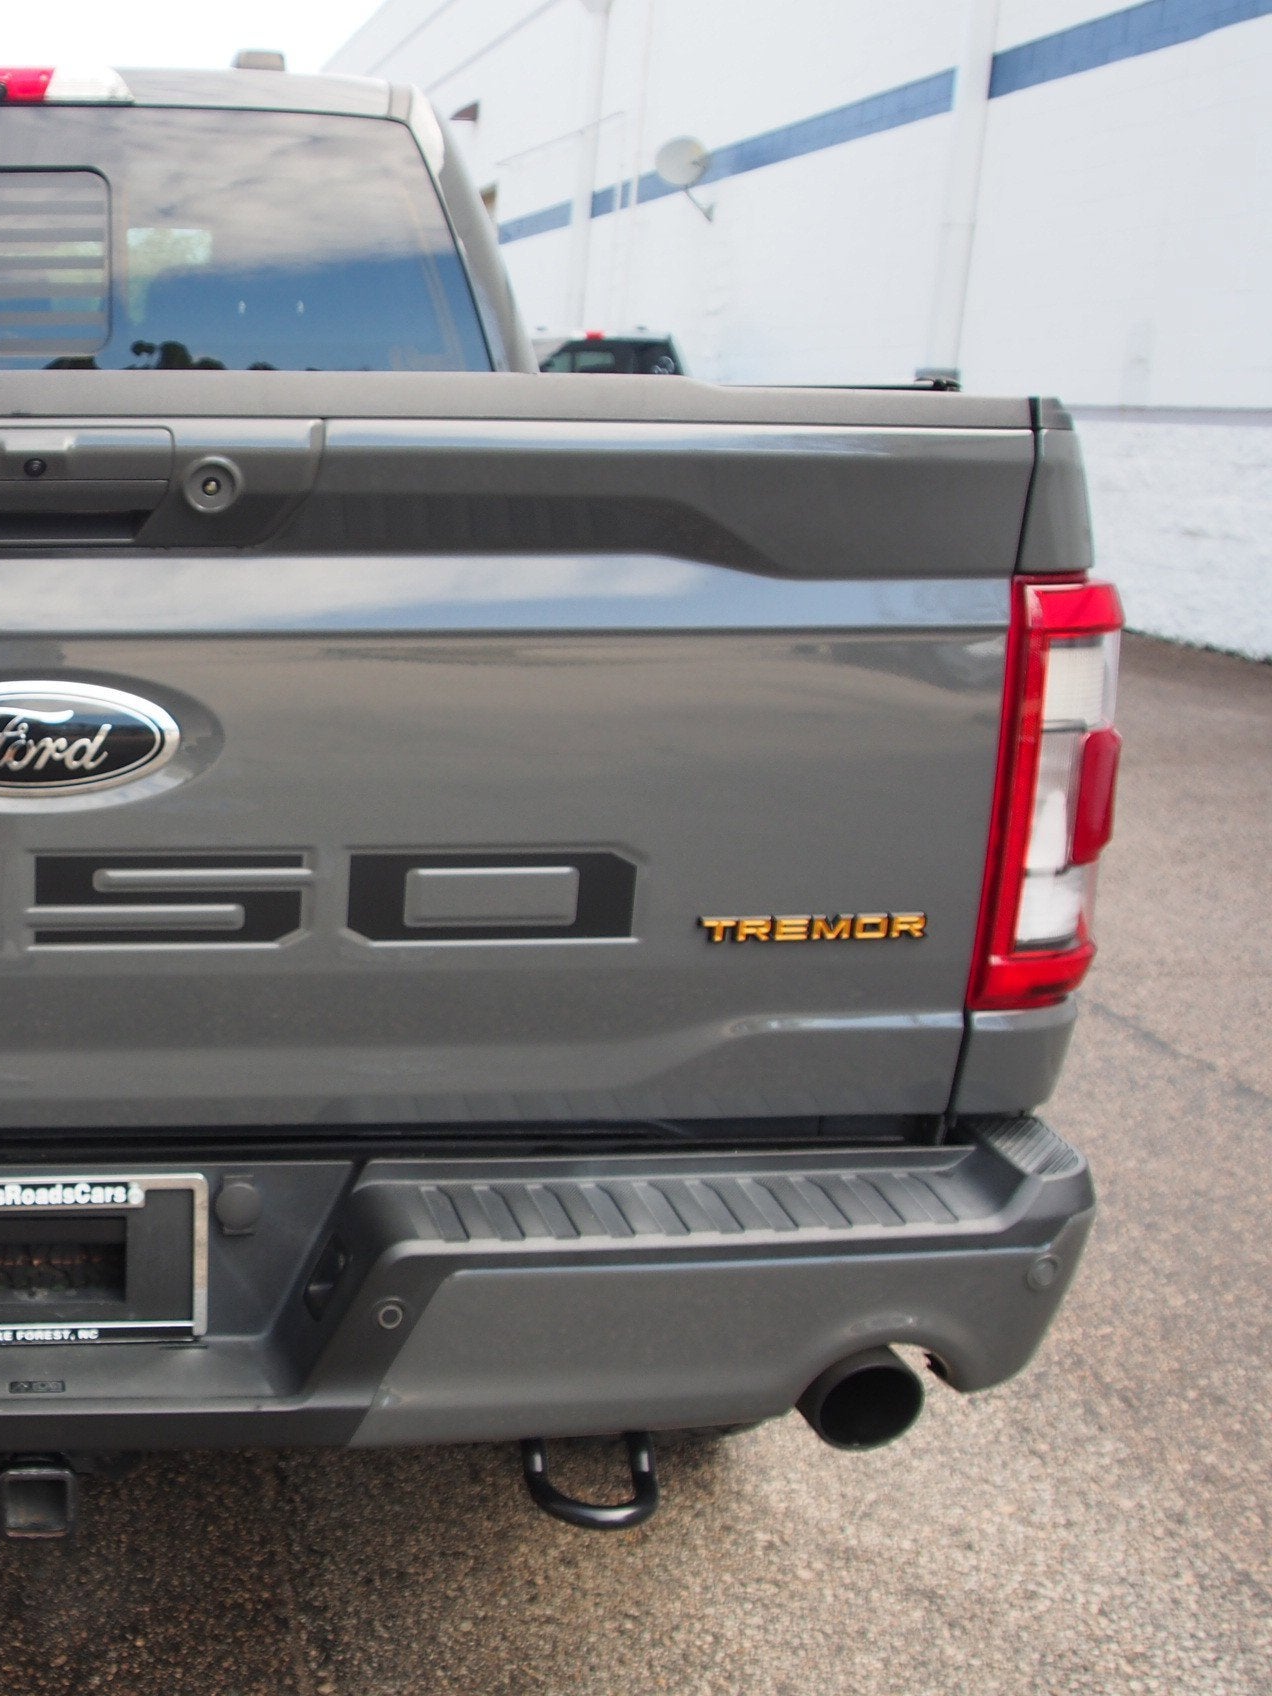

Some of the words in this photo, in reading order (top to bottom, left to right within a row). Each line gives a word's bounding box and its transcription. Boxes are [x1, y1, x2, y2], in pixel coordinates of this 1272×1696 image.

[698, 911, 927, 942] TREMOR
[15, 1329, 75, 1341] FOREST,
[77, 1328, 99, 1340] NC
